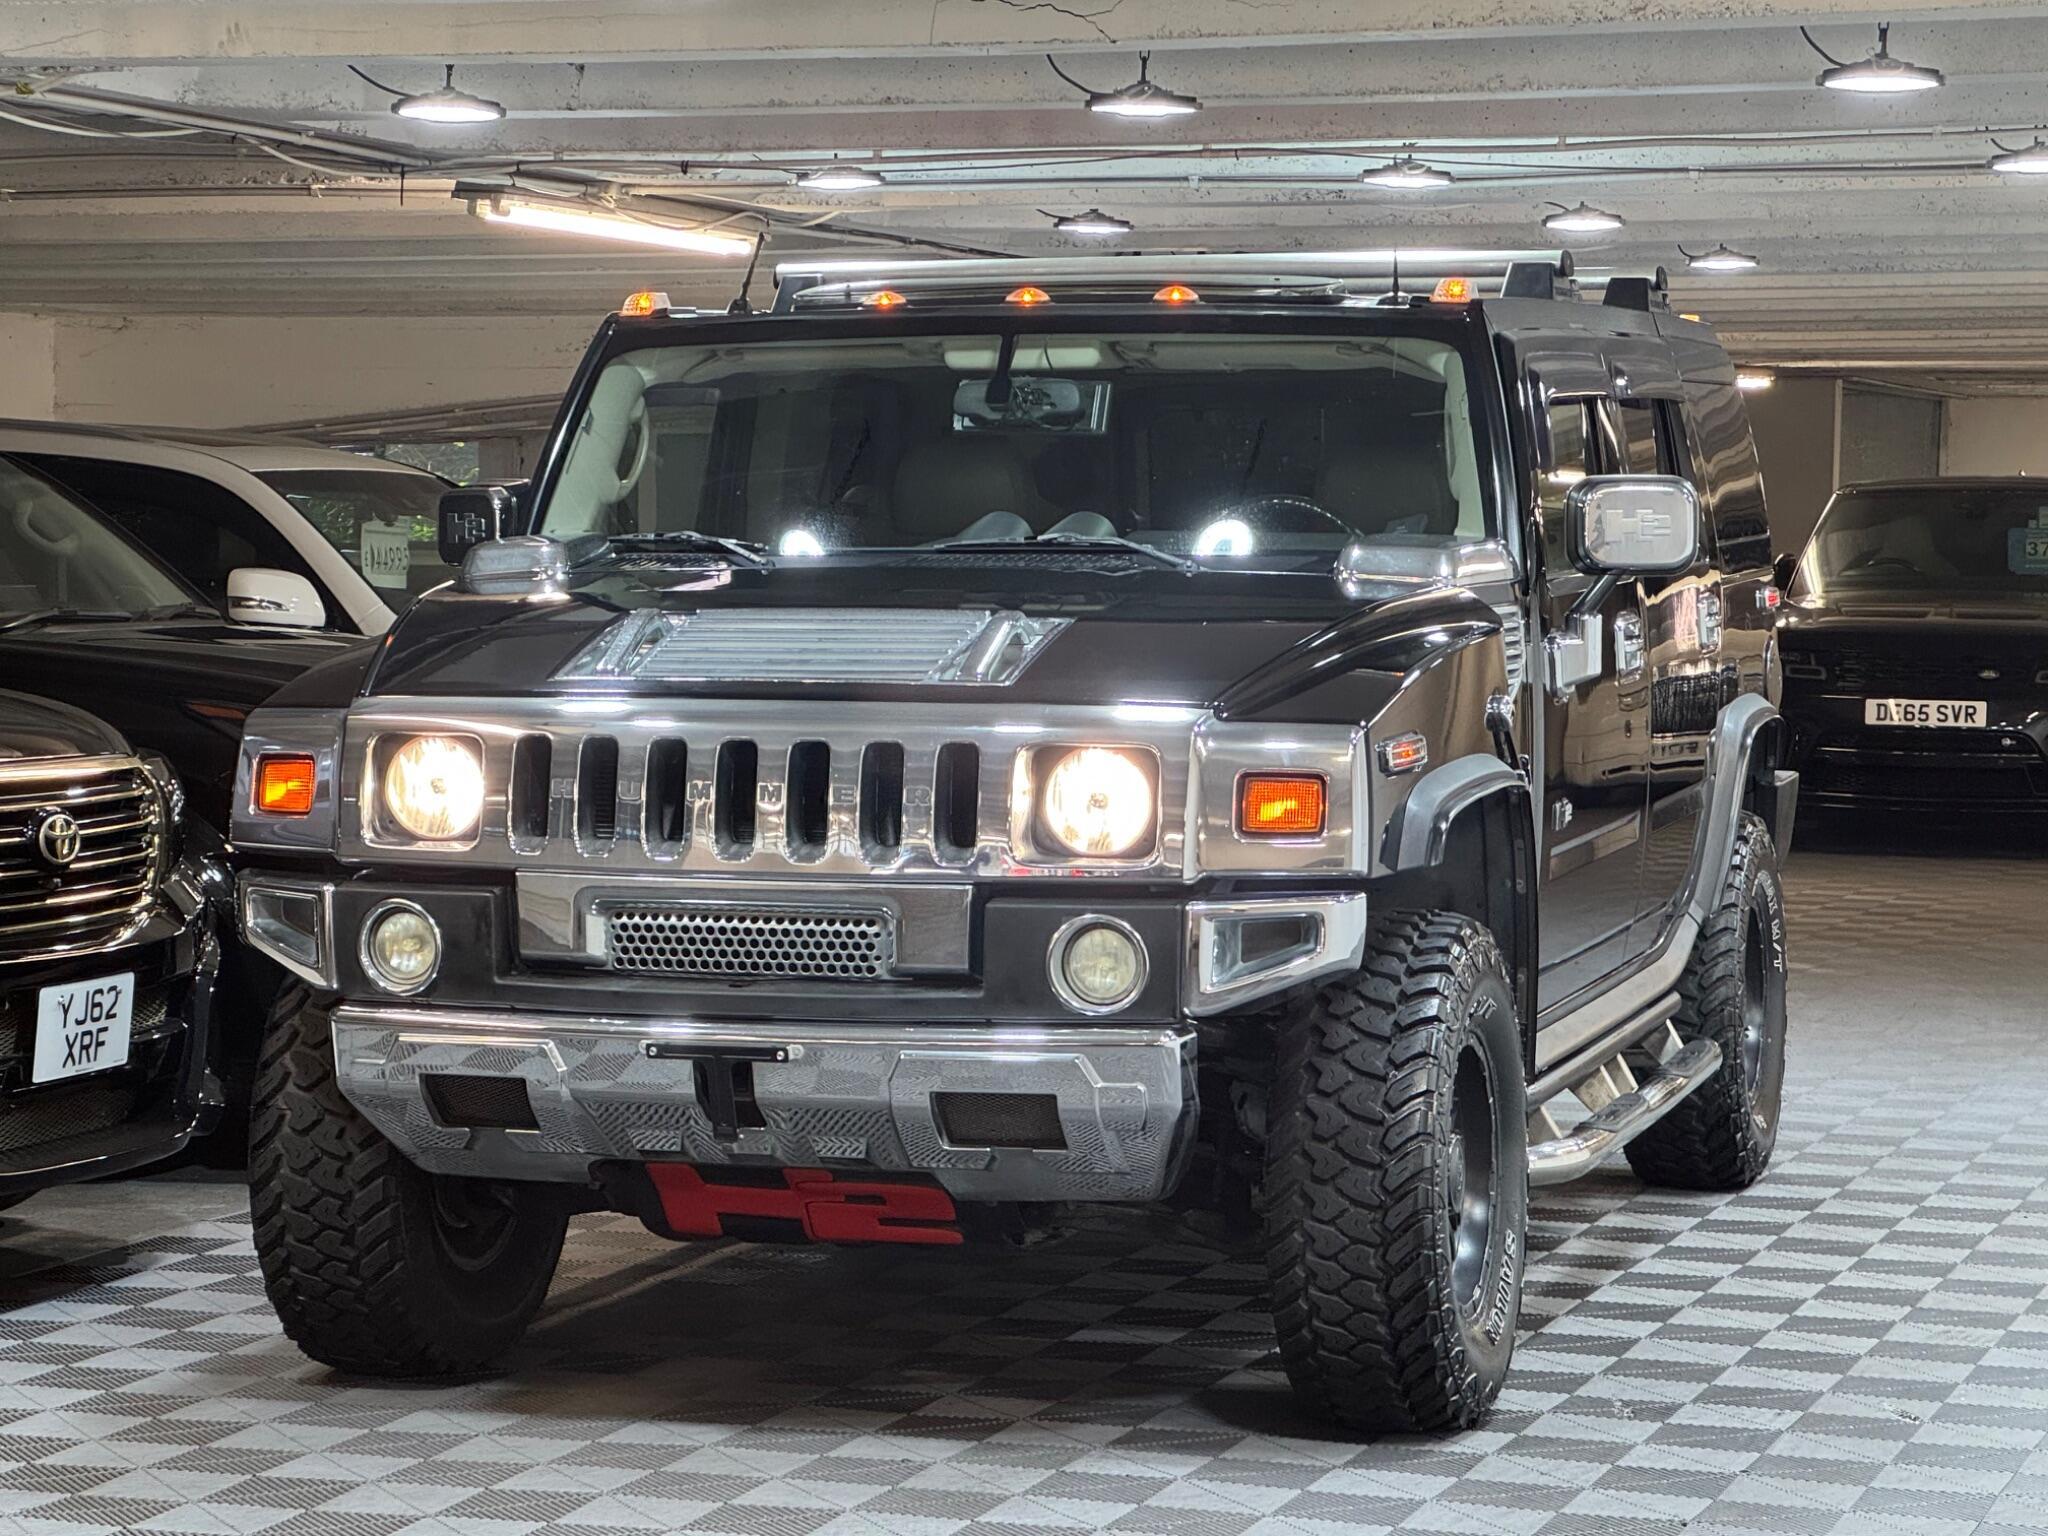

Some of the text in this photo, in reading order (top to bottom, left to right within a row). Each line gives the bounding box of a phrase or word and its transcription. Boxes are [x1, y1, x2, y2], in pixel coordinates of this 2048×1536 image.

[1936, 704, 1978, 723] SVR
[550, 777, 932, 806] HUMMER
[58, 985, 119, 1028] YJ62
[62, 1026, 109, 1068] XRF
[645, 1161, 964, 1245] H2
